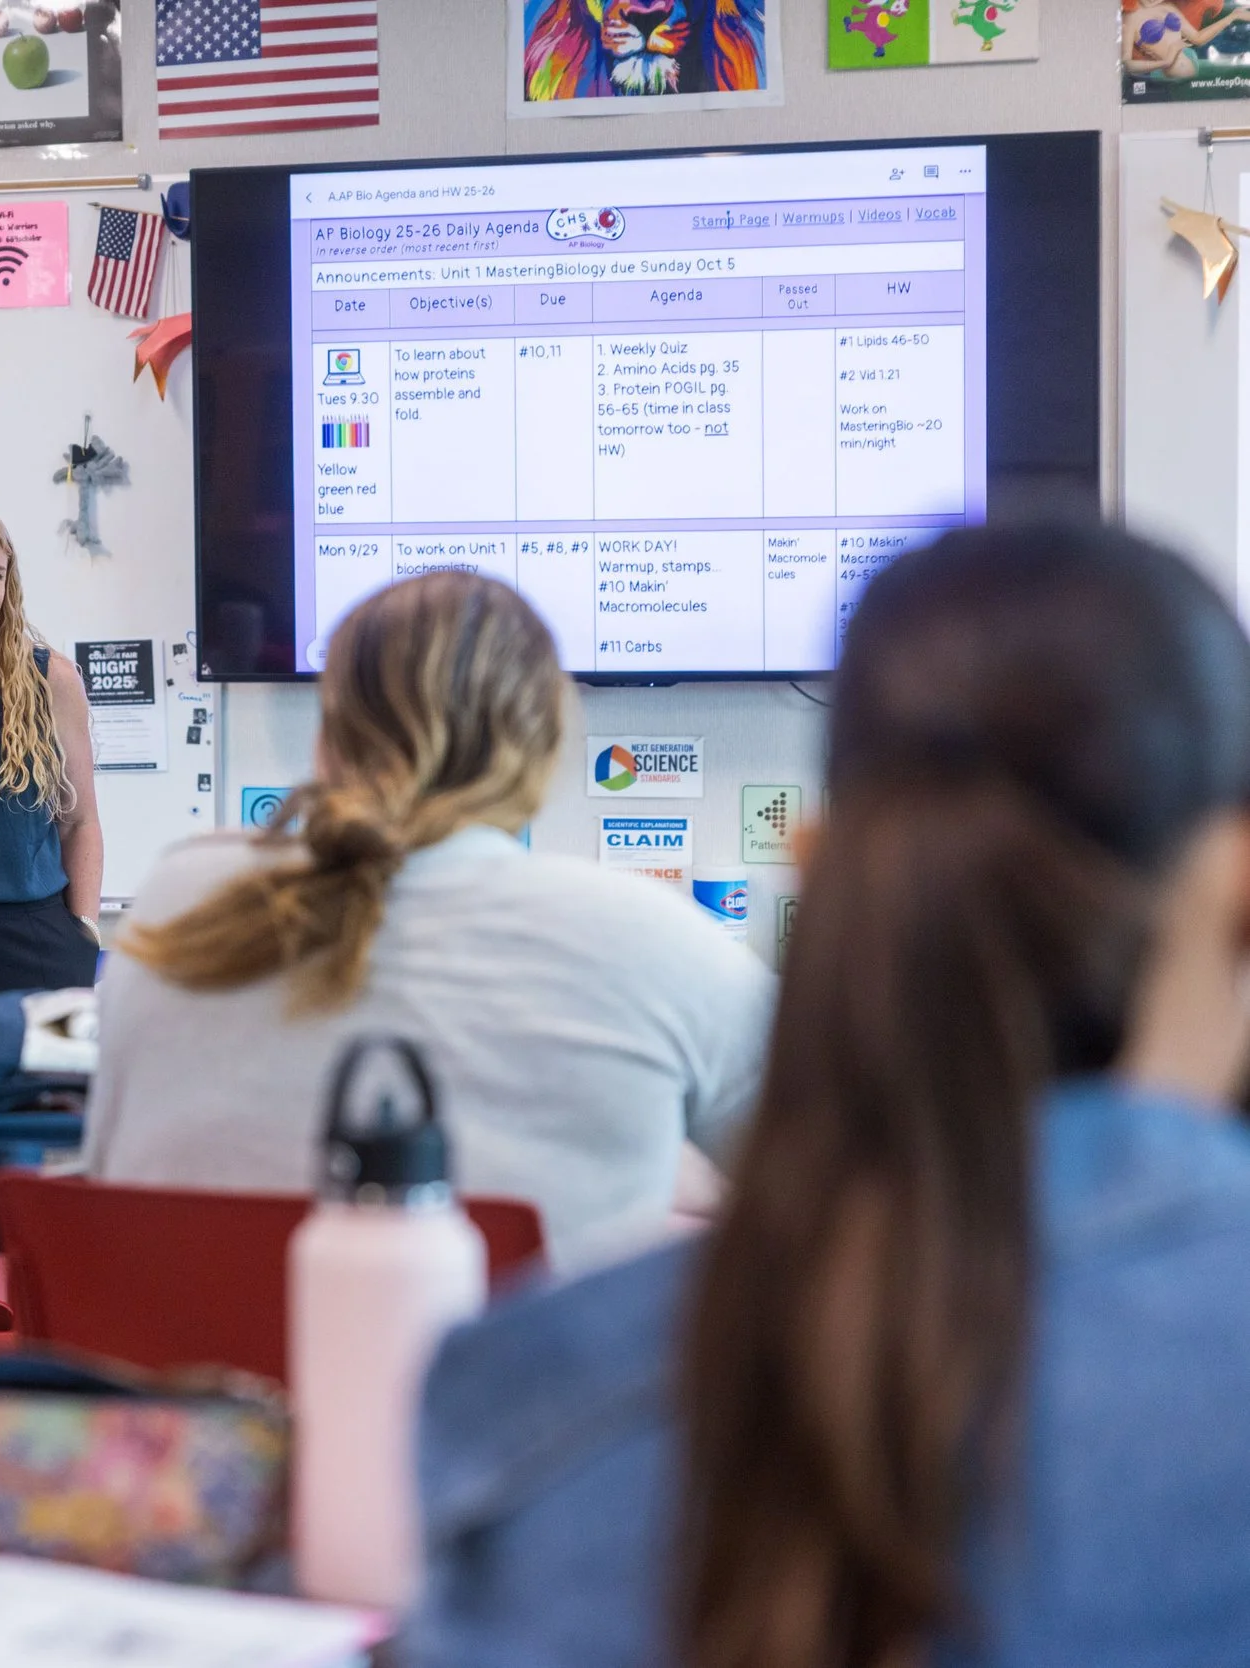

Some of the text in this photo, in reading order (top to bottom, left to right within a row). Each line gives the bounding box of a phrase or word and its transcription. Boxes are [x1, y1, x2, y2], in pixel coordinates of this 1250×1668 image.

[355, 186, 495, 202] Bio Agenda and HW 25-26
[739, 213, 770, 229] Page
[782, 211, 845, 227] Warmups
[858, 209, 902, 223] Videos
[915, 206, 957, 221] Vocab
[315, 221, 539, 243] AP Biology 25-26 Daily Agenda
[328, 240, 499, 256] reverse order recent first)
[316, 258, 722, 285] Announcements: Unit MasteringBiology due Sunday Oct
[334, 281, 911, 312] Date Objective(s) Due Agenda Passed HW
[788, 299, 809, 310] Out
[856, 333, 930, 348] Lipids 46-50
[395, 347, 486, 362] To learn about
[519, 345, 562, 360] #10,11
[610, 342, 688, 358] Weekly Quiz
[394, 367, 476, 384] how proteins
[613, 360, 740, 376] Amino Acids 35
[840, 369, 876, 381] #2 Vid
[394, 386, 481, 401] assemble and
[613, 381, 707, 396] Protein POGIL
[317, 391, 379, 405] Tues 9.30
[598, 401, 731, 417] 56-65 (time class
[840, 403, 887, 415] Work on
[598, 422, 729, 436] tomorrow too not
[840, 418, 943, 434] MasteringBio ~20
[598, 443, 626, 458] HW)
[840, 437, 896, 451] min/night
[317, 463, 358, 476] Yellow
[317, 482, 377, 498] green red
[318, 503, 344, 515] blue
[397, 542, 498, 556] To work on Unit
[521, 541, 589, 556] #5, #8, #9
[599, 540, 640, 553] WORK
[840, 537, 865, 548] #10
[318, 543, 378, 558] Mon 9/29
[768, 553, 827, 564] Macromole
[599, 559, 658, 574] Warmup,
[768, 569, 796, 580] cules
[599, 580, 625, 593] #10
[599, 599, 707, 613] Macromolecules
[600, 639, 662, 653] #11 Carbs
[89, 661, 138, 674] NIGHT
[92, 676, 132, 690] 2025
[631, 743, 694, 752] NEXT GENERATION
[633, 754, 698, 773] SCIENCE
[640, 774, 682, 783] STANDARDS
[607, 833, 684, 846] CLAIM
